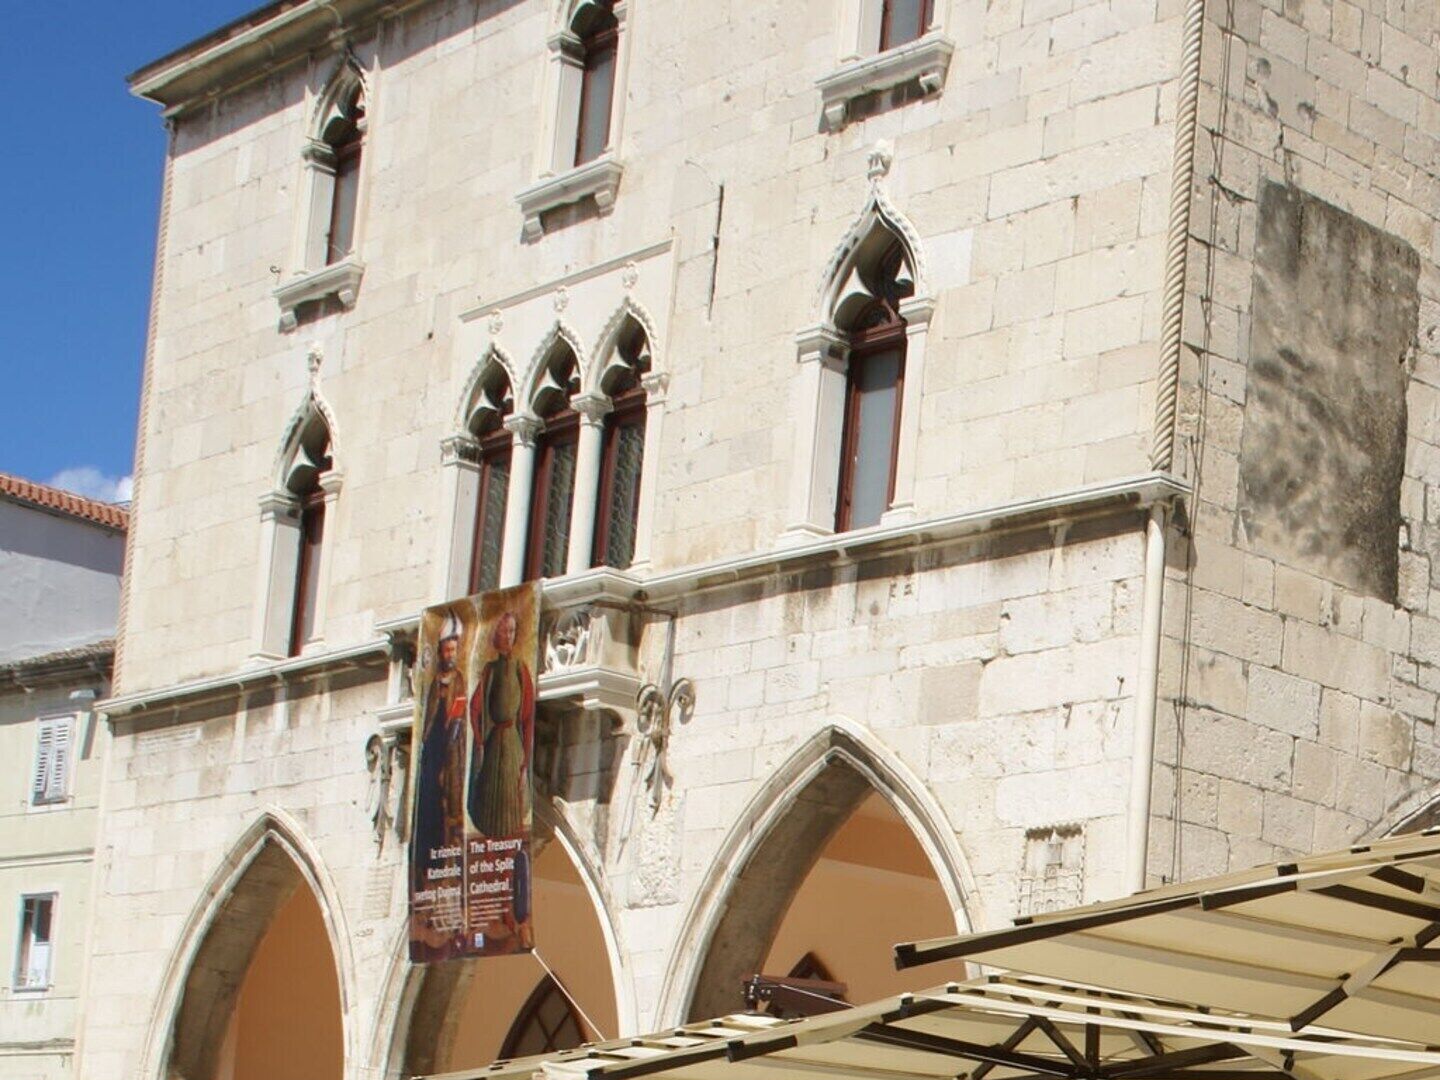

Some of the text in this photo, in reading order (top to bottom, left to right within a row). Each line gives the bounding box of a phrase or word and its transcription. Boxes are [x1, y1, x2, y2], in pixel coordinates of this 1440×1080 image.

[470, 838, 523, 853] The Treasury
[427, 865, 461, 880] Katedrale
[469, 858, 514, 874] of the Split
[470, 877, 510, 895] Cathedral
